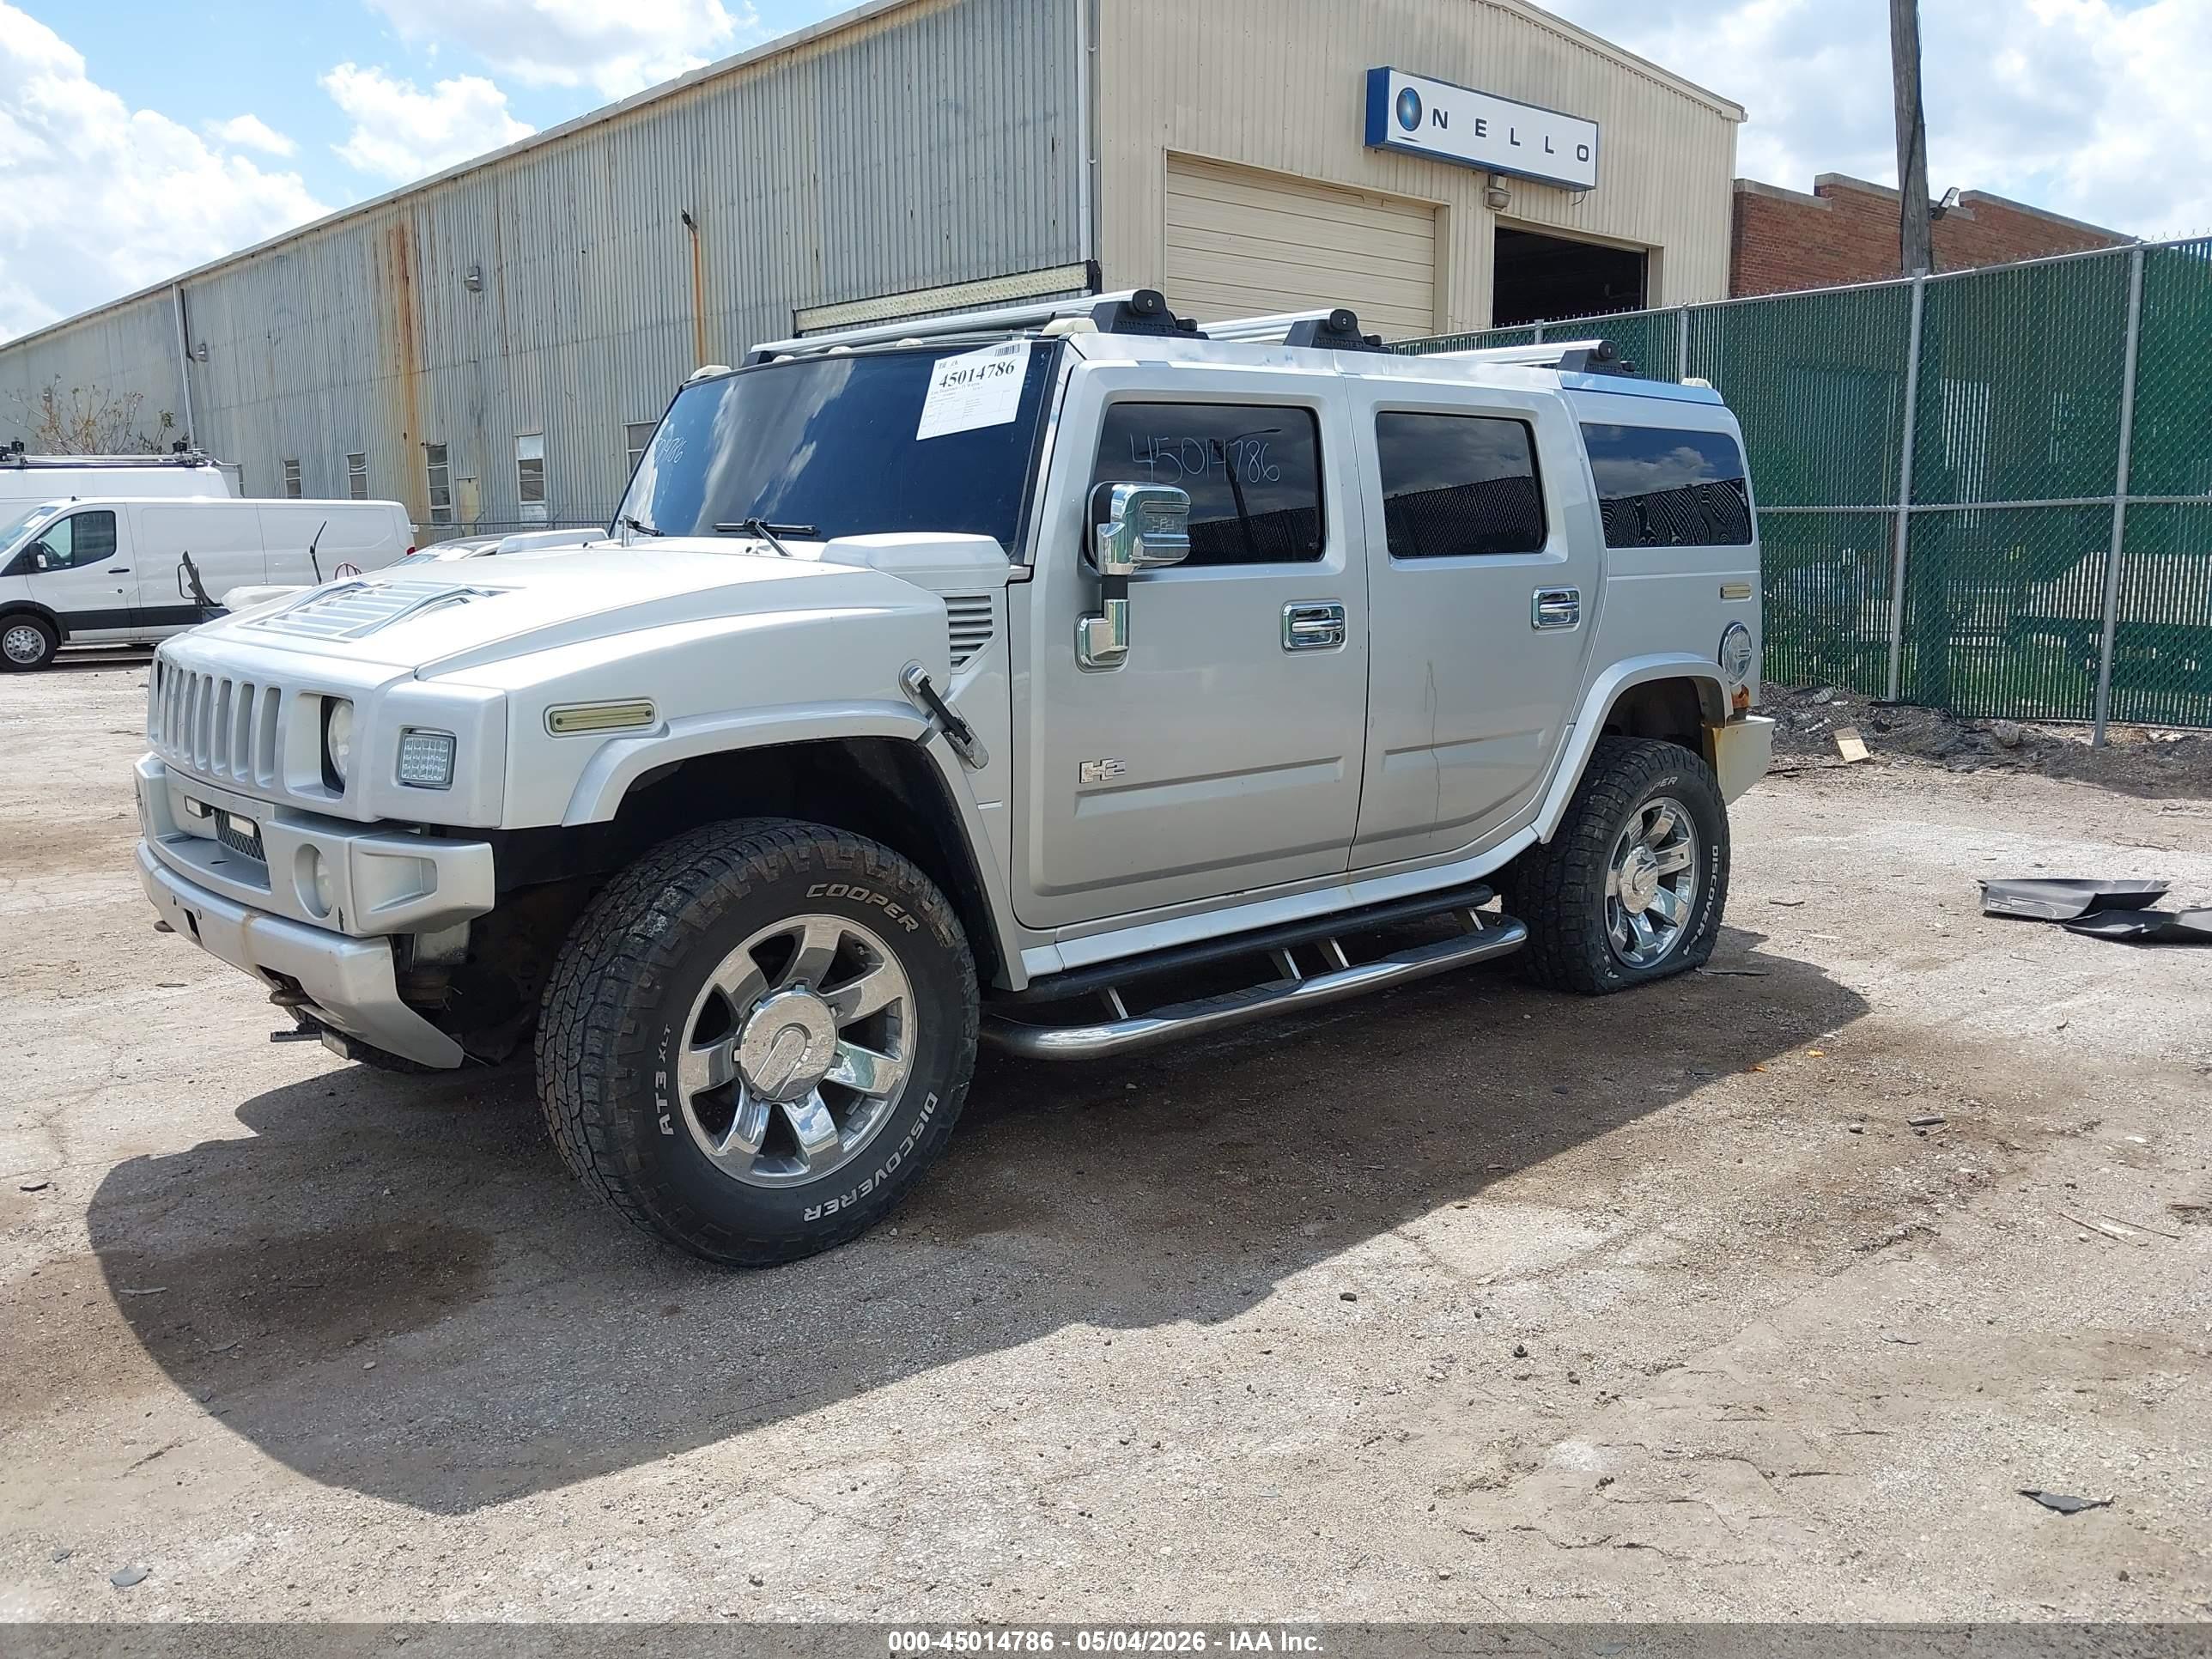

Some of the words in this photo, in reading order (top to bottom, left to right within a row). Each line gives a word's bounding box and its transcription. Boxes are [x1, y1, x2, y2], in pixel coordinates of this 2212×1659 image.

[939, 359, 1017, 387] 45014786
[1129, 433, 1280, 483] 45014786
[806, 884, 920, 933] COOPER
[658, 1023, 671, 1064] XLT
[655, 1071, 674, 1135] AT3
[803, 1091, 939, 1222] DISCOVERER
